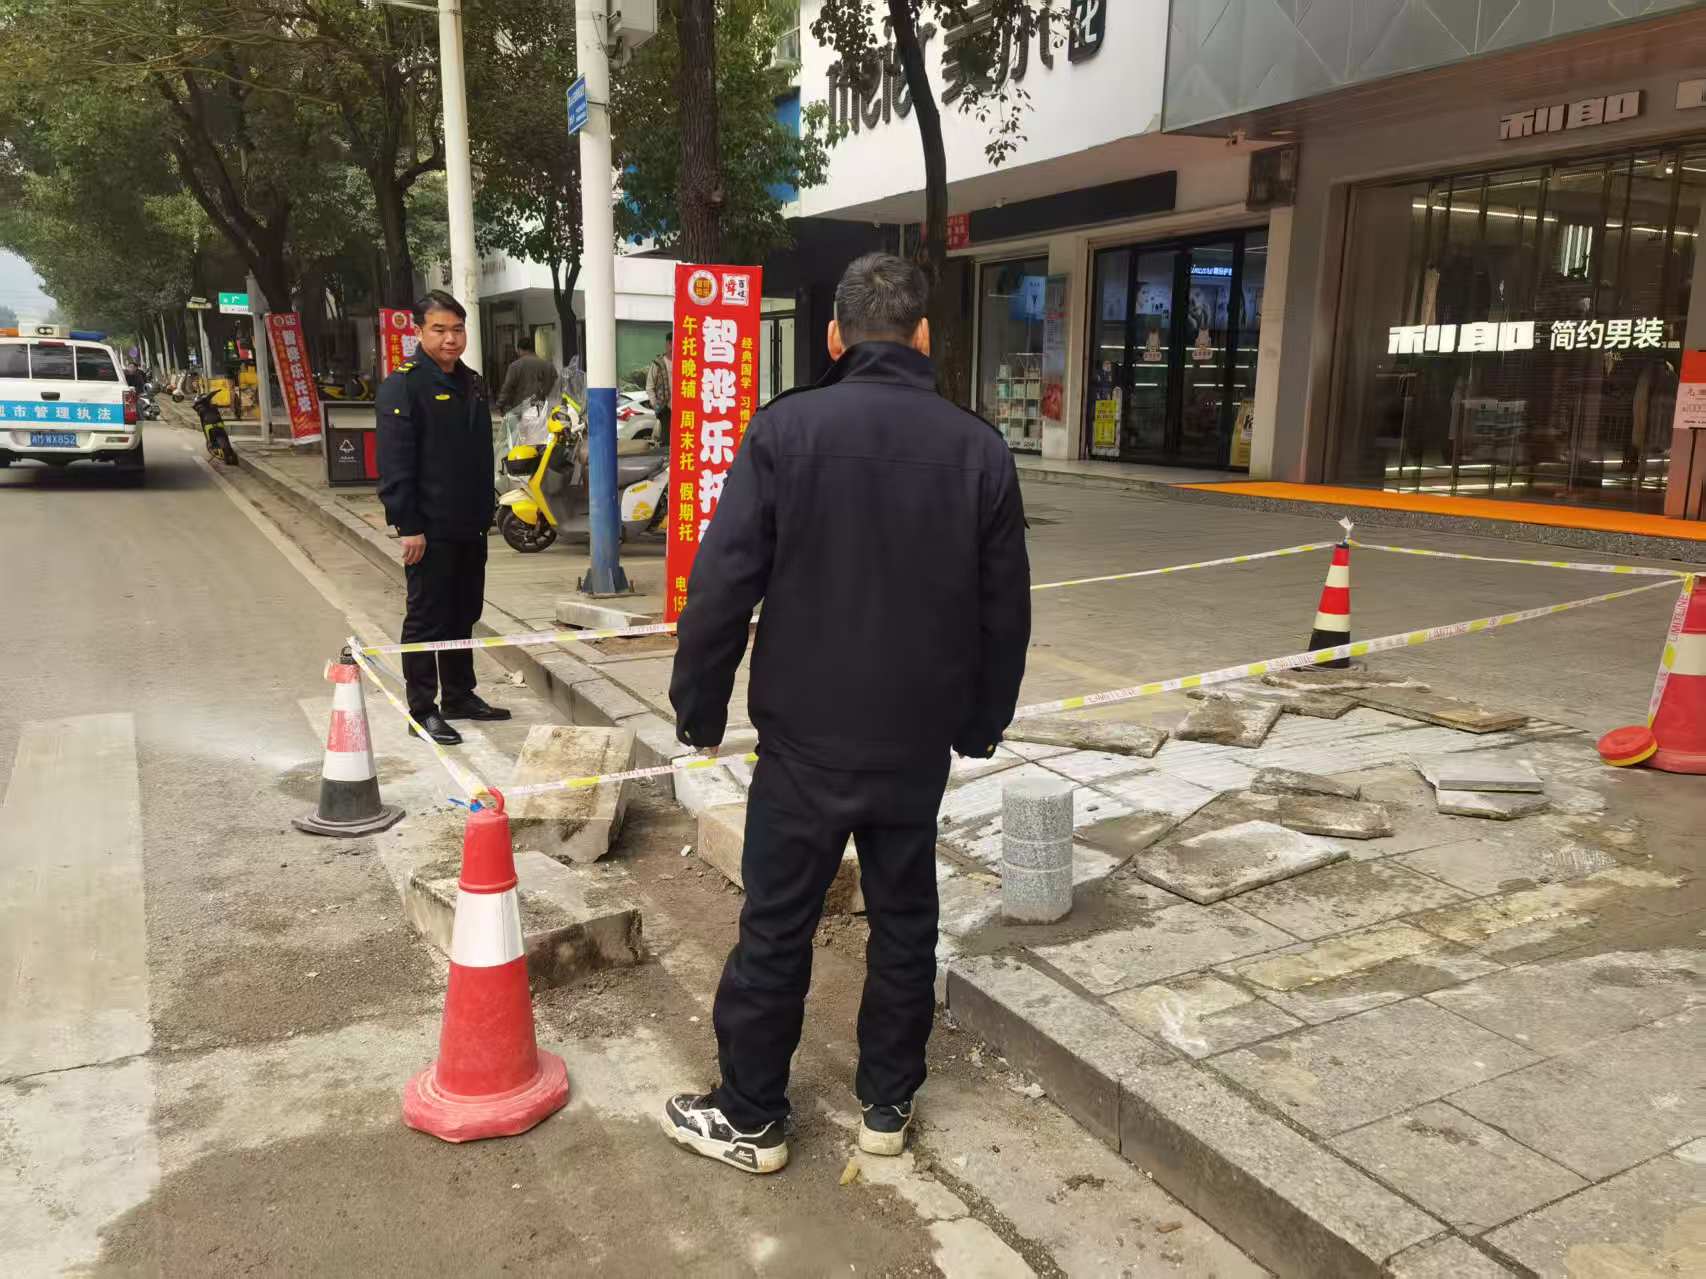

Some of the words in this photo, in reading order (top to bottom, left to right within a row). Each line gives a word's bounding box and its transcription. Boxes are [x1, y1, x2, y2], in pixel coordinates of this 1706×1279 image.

[681, 315, 698, 399] 午托晚辅
[1550, 317, 1664, 350] 简约男装
[680, 411, 695, 471] 周末托
[698, 316, 738, 543] 智铧乐托
[678, 482, 695, 541] 假期托
